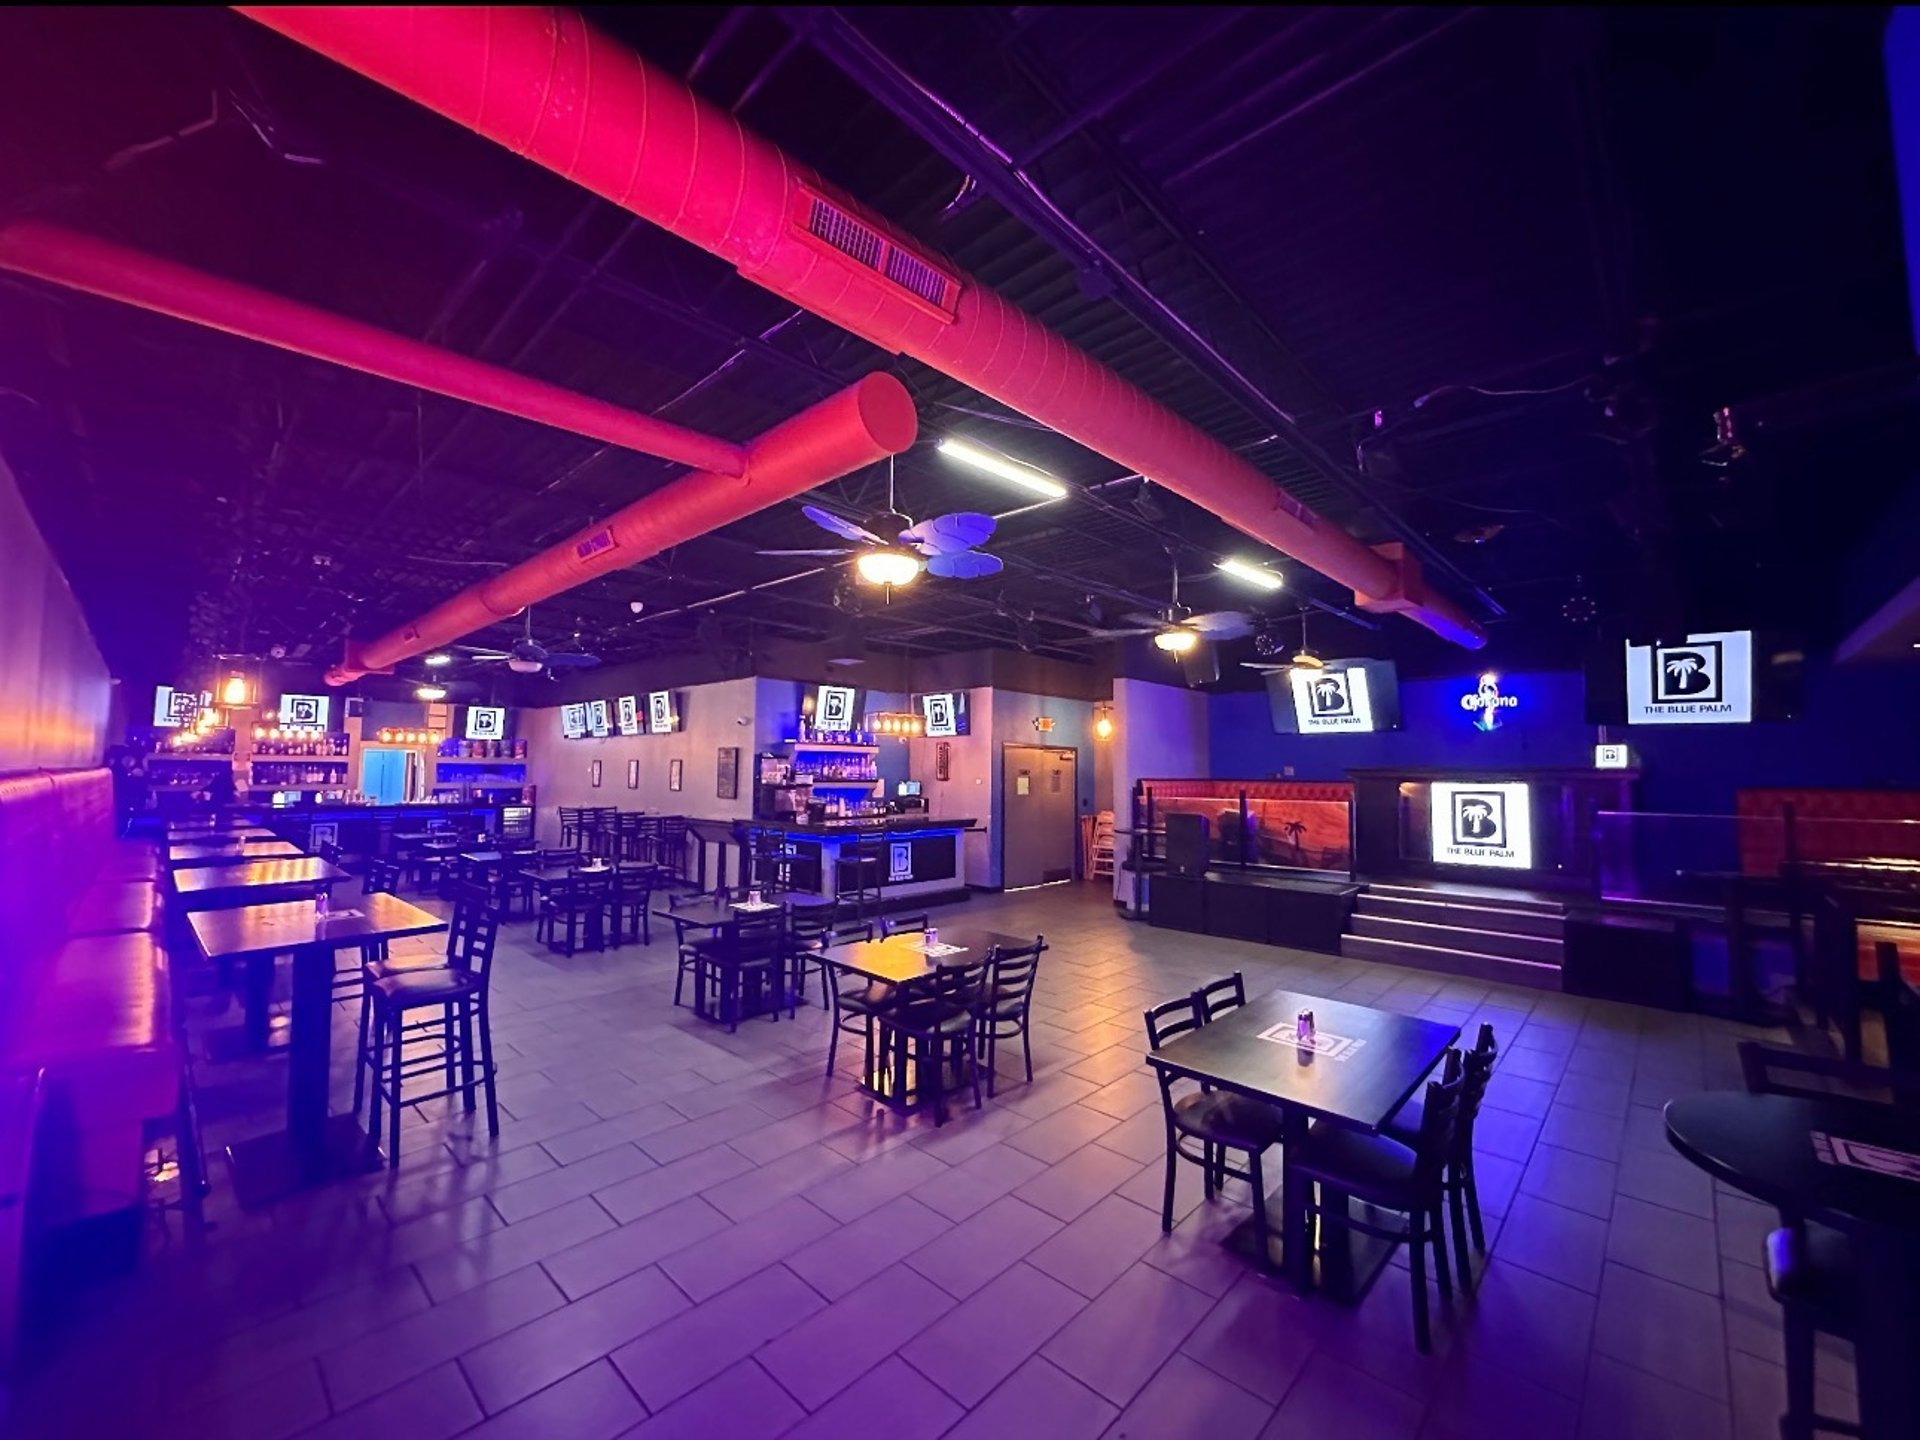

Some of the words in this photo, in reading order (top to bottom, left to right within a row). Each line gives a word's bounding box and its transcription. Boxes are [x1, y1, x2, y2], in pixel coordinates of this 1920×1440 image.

[1663, 652, 1711, 696] B
[1315, 678, 1345, 711] B
[1461, 694, 1517, 711] Corona
[1644, 706, 1665, 714] THE
[1667, 705, 1696, 713] BLUE
[1700, 704, 1732, 712] PALM
[1461, 799, 1497, 839] B
[1447, 847, 1461, 855] THE
[1464, 848, 1485, 856] BLUE
[1489, 849, 1515, 858] PALM
